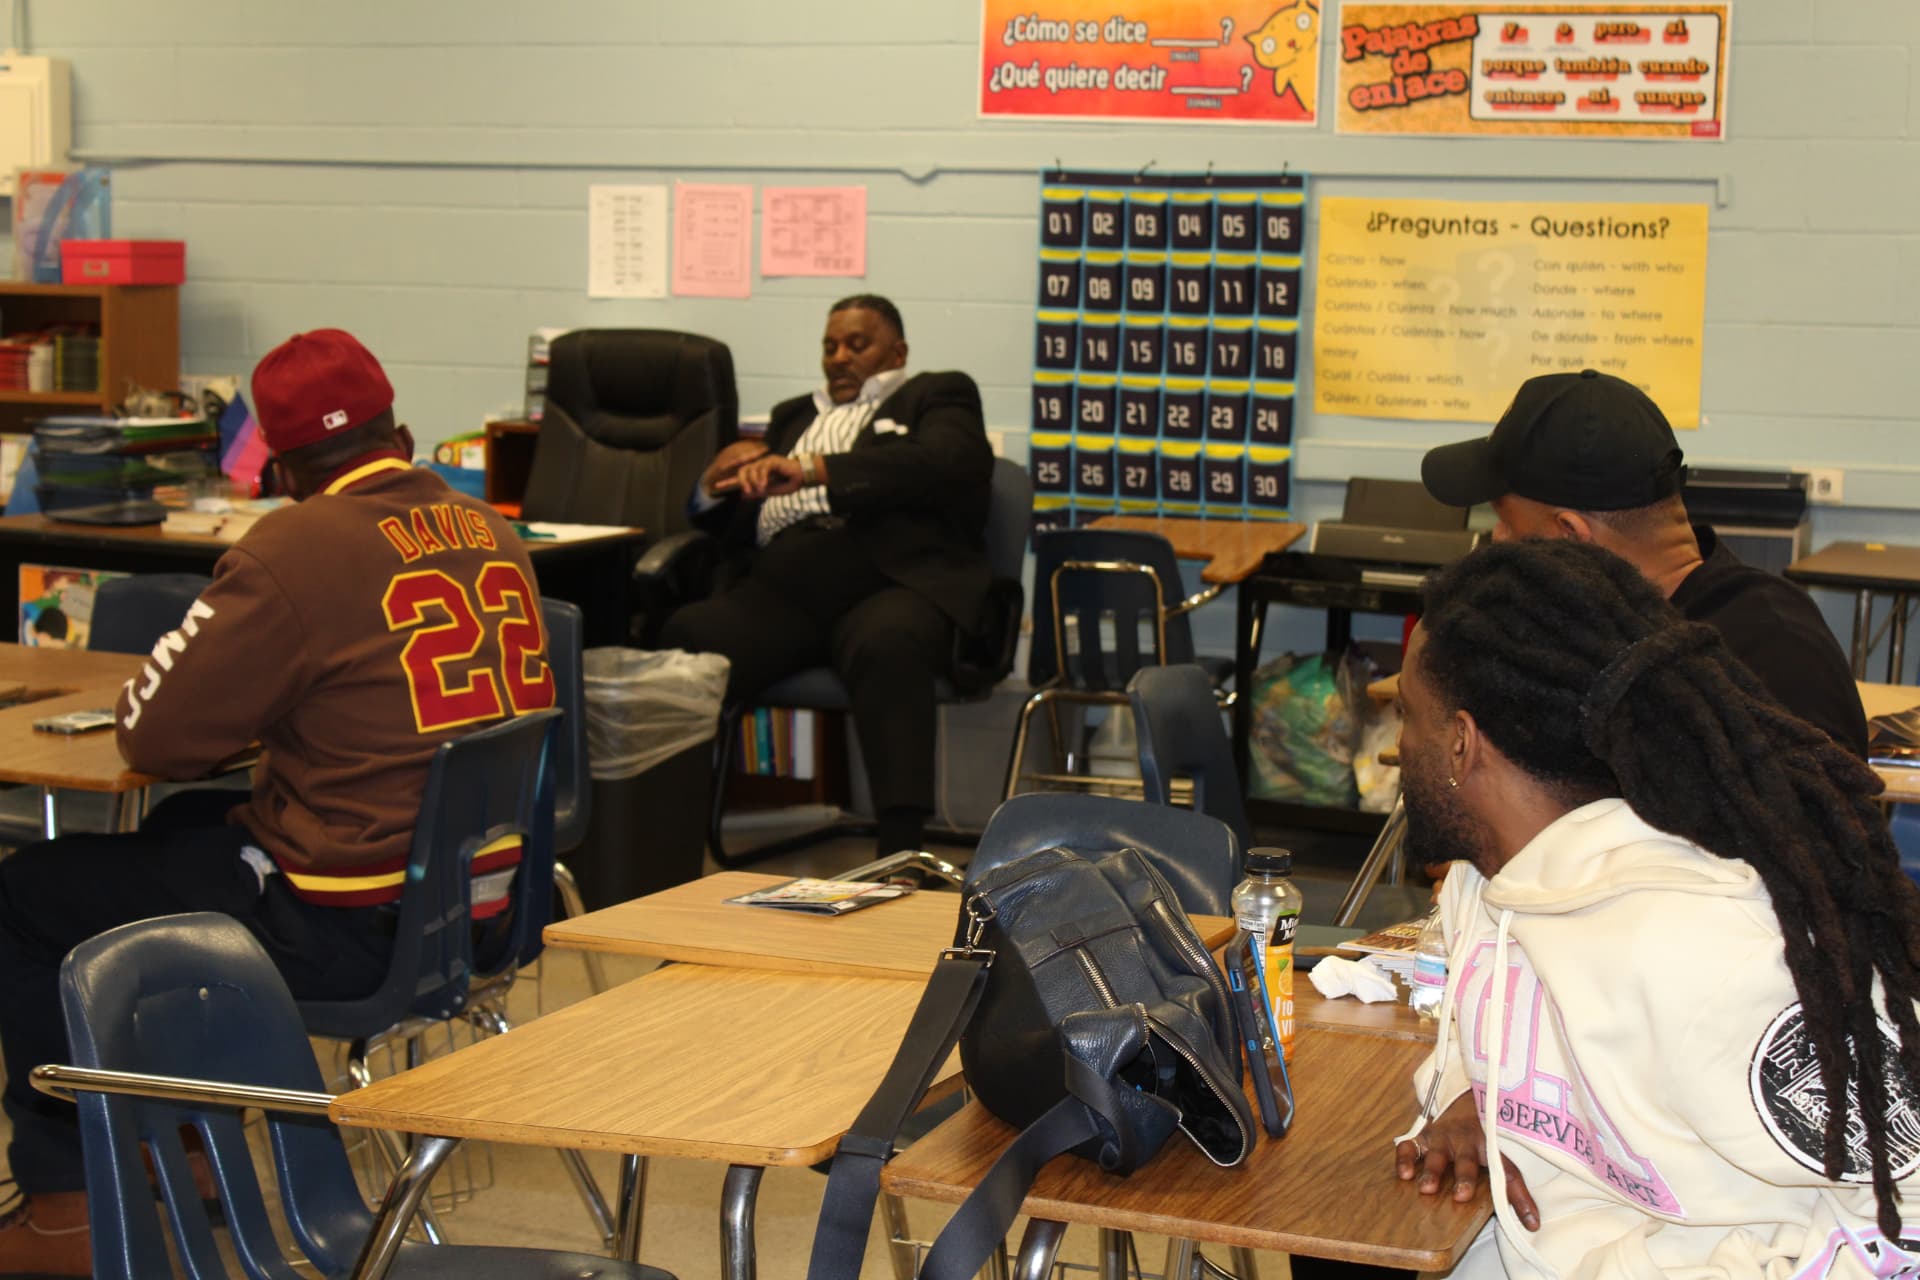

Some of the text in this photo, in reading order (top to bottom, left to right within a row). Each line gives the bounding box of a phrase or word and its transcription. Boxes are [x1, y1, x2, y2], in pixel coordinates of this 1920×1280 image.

[1003, 11, 1070, 47] ¿Cómo
[1074, 21, 1099, 43] se
[1103, 15, 1148, 43] dice
[1341, 14, 1480, 62] Palabras
[1504, 21, 1519, 40] y
[1558, 22, 1573, 36] o
[1595, 22, 1640, 39] pero
[1390, 50, 1431, 76] de
[1481, 58, 1547, 77] porque
[1554, 57, 1631, 74] también
[1638, 58, 1709, 74] cuando
[989, 60, 1041, 93] ¿Qué
[1044, 61, 1110, 94] quiere
[1113, 63, 1168, 91] decir
[1348, 68, 1469, 111] enlace
[1484, 88, 1566, 105] entonces
[1634, 90, 1706, 109] aunque
[1049, 212, 1290, 239] 01 02 03 04 05 06
[1366, 211, 1499, 239] ¿Preguntas
[1530, 217, 1671, 239] Questions?
[1380, 255, 1406, 265] how
[1533, 260, 1561, 272] Con
[1621, 261, 1649, 272] with
[1656, 262, 1684, 273] who
[1047, 275, 1287, 305] 07 08 09 10 11 12
[1393, 279, 1425, 289] when
[1593, 285, 1635, 296] where
[1480, 306, 1517, 317] much
[1601, 309, 1615, 320] to
[1621, 310, 1663, 321] where
[1459, 328, 1486, 339] how
[1532, 332, 1549, 343] De
[1614, 333, 1646, 345] from
[1652, 334, 1694, 346] where
[1044, 336, 1285, 368] 13 14 15 16 17 18
[1322, 348, 1359, 360] many
[1531, 355, 1552, 366] Por
[1601, 357, 1627, 370] why
[1427, 373, 1463, 385] which
[1443, 398, 1471, 409] who
[1039, 397, 1279, 432] 19 20 21 22 23 24
[1038, 462, 1277, 497] 25 26 27 28 29 30
[378, 504, 497, 564] DAVIS
[381, 561, 556, 734] 22
[1479, 1090, 1661, 1207] SERVES ART
